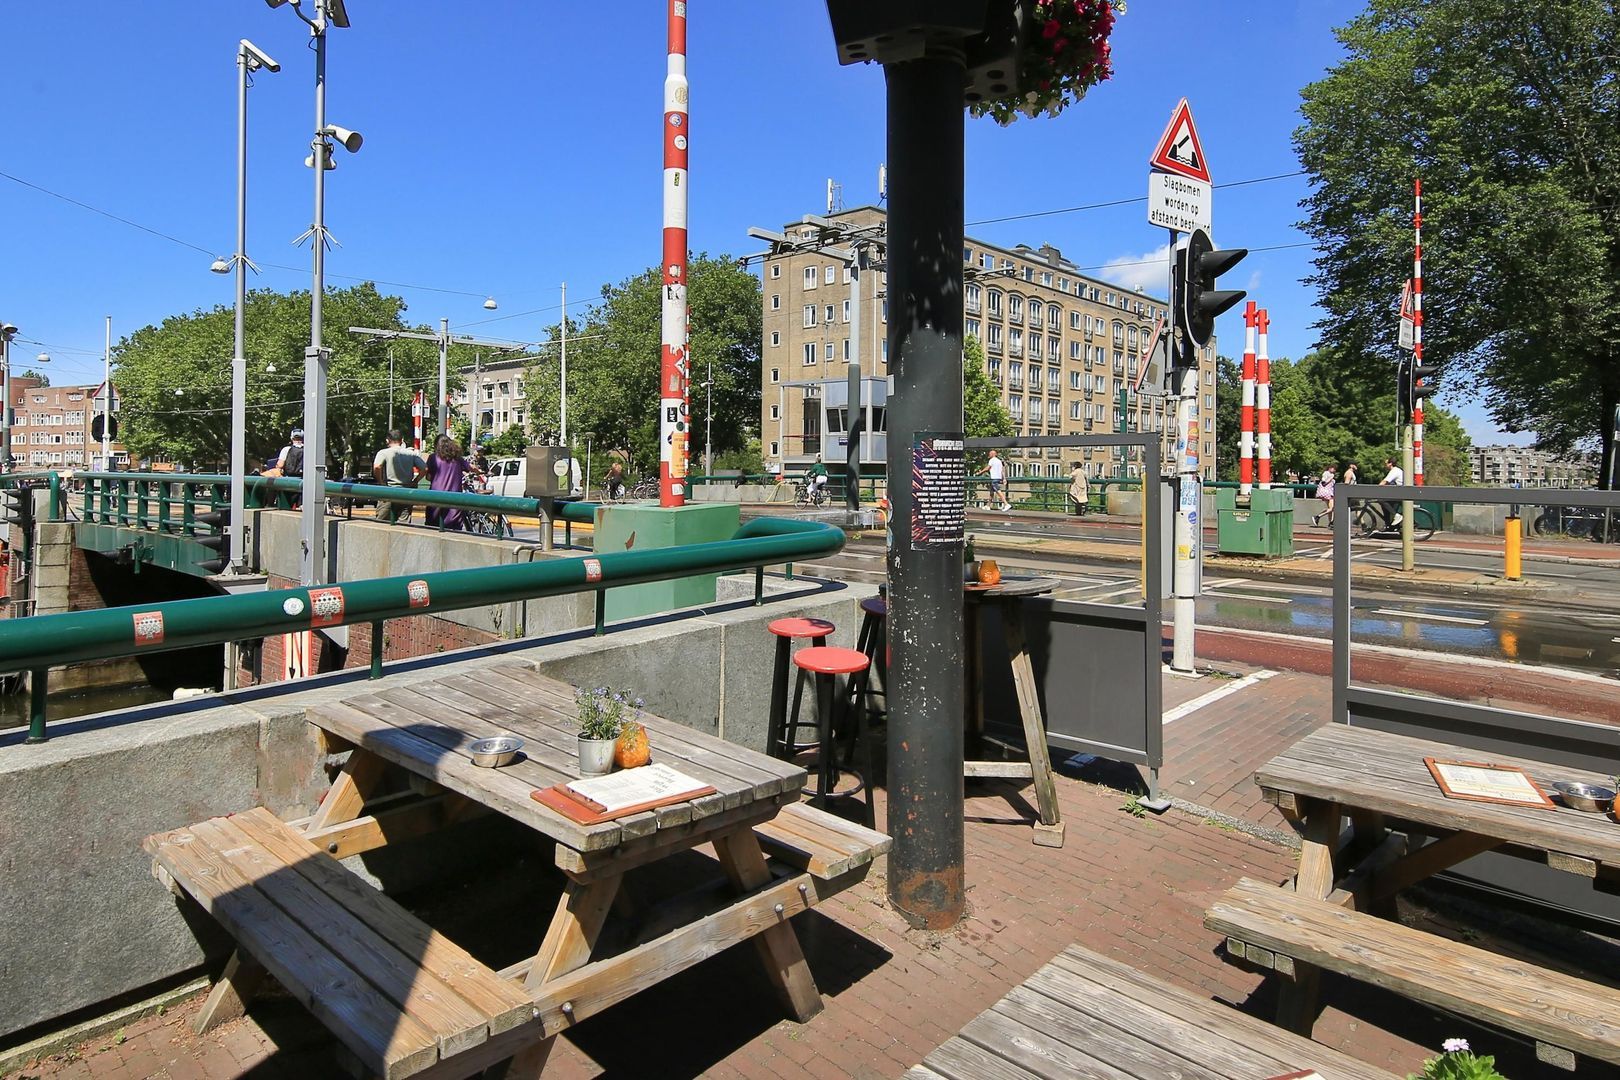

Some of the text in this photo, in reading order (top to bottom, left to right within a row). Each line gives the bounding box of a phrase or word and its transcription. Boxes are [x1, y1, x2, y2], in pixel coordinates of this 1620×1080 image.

[1164, 175, 1200, 197] Slagbomen
[1165, 197, 1199, 216] worden op
[1151, 209, 1210, 234] afstand bestd
